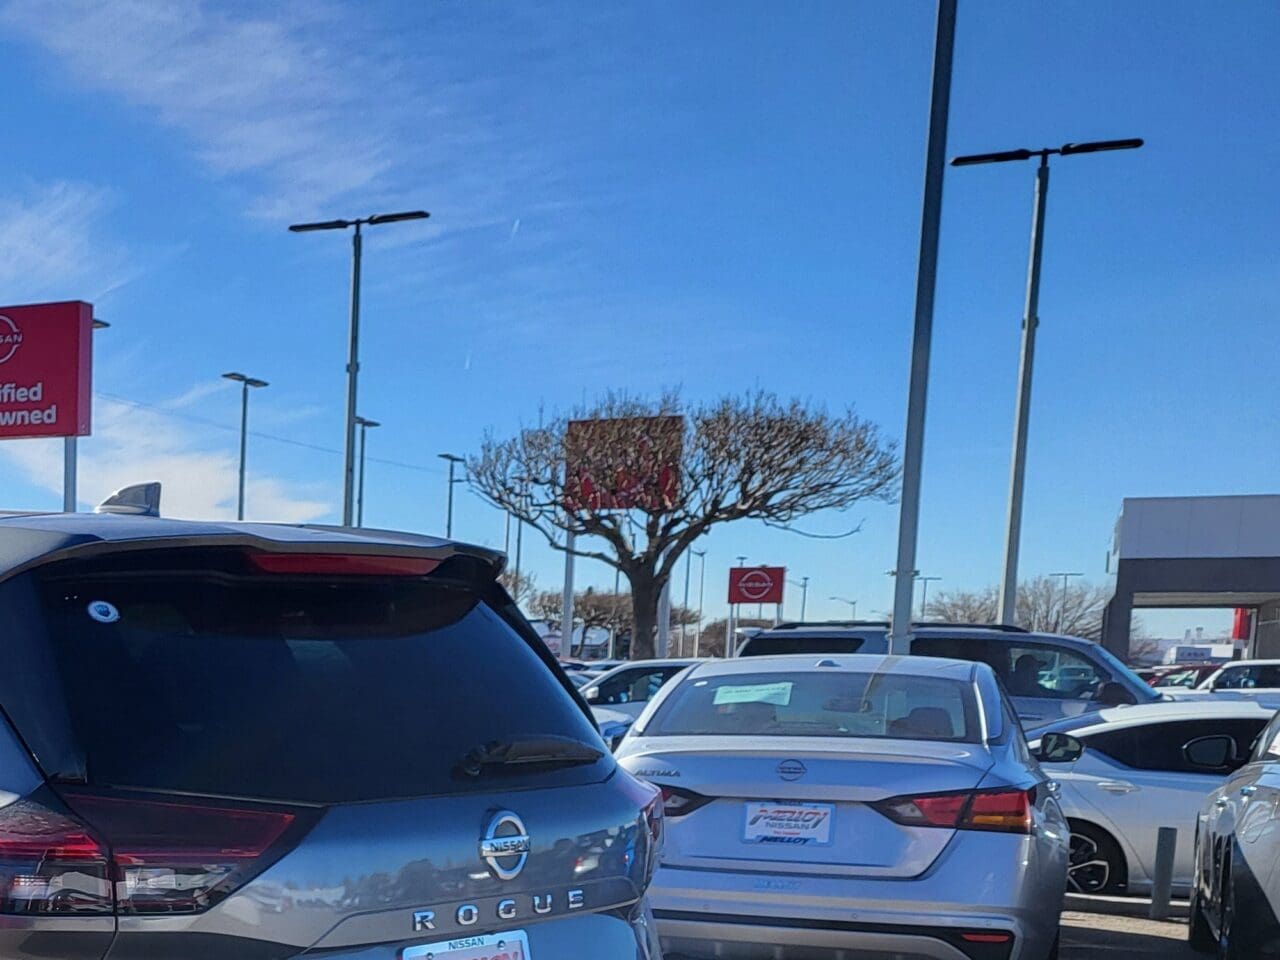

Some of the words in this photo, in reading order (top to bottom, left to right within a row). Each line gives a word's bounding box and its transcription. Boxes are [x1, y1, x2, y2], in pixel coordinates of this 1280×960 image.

[489, 838, 530, 852] NISSAN
[412, 889, 584, 931] ROGUE
[448, 936, 485, 950] NISSAN
